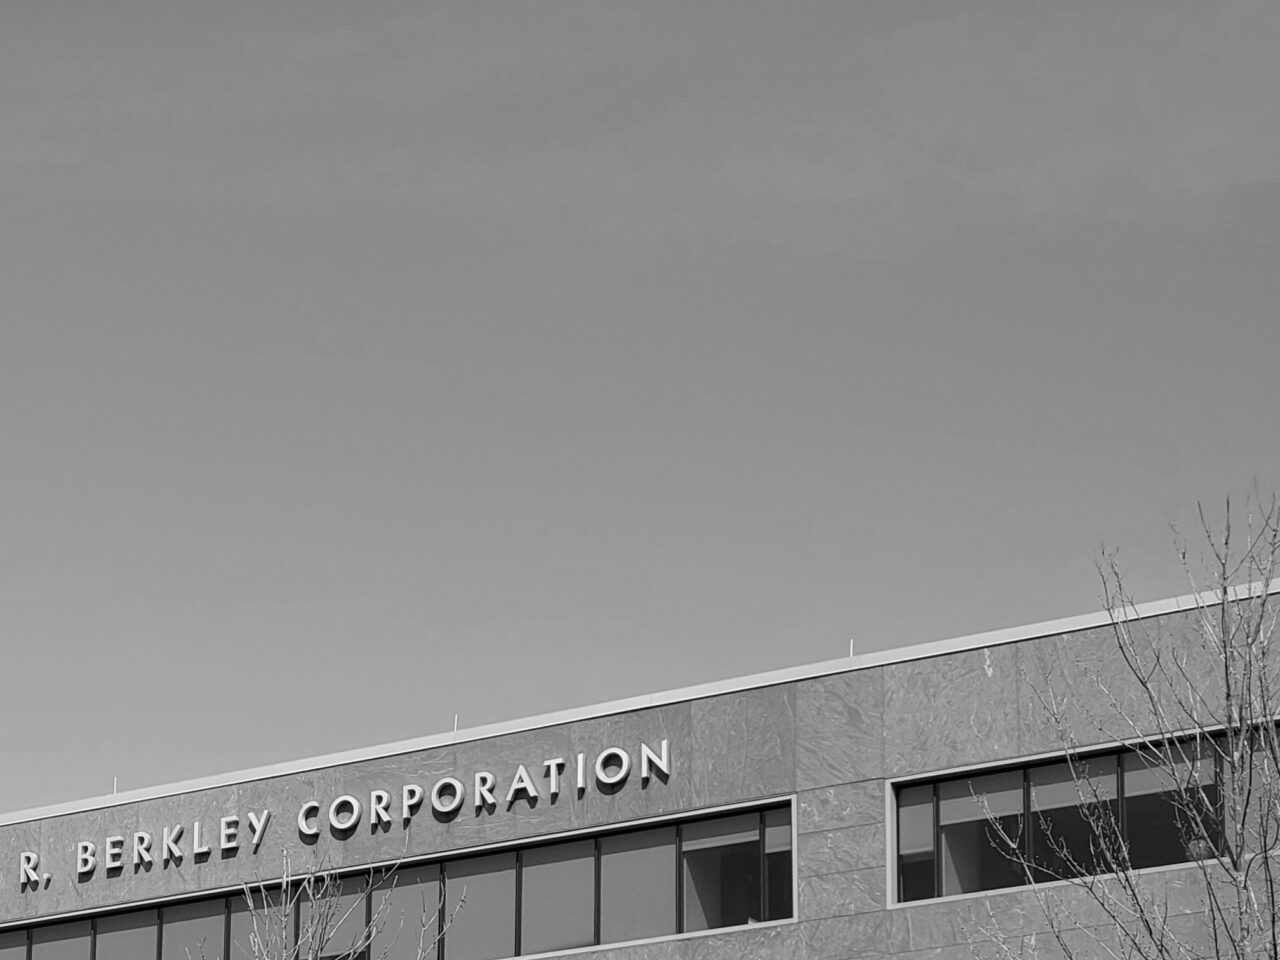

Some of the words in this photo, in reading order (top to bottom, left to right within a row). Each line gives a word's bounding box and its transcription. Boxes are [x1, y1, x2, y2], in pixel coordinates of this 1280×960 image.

[20, 852, 50, 891] R.
[76, 810, 270, 878] BERKLEY
[297, 739, 670, 844] CORPORATION
